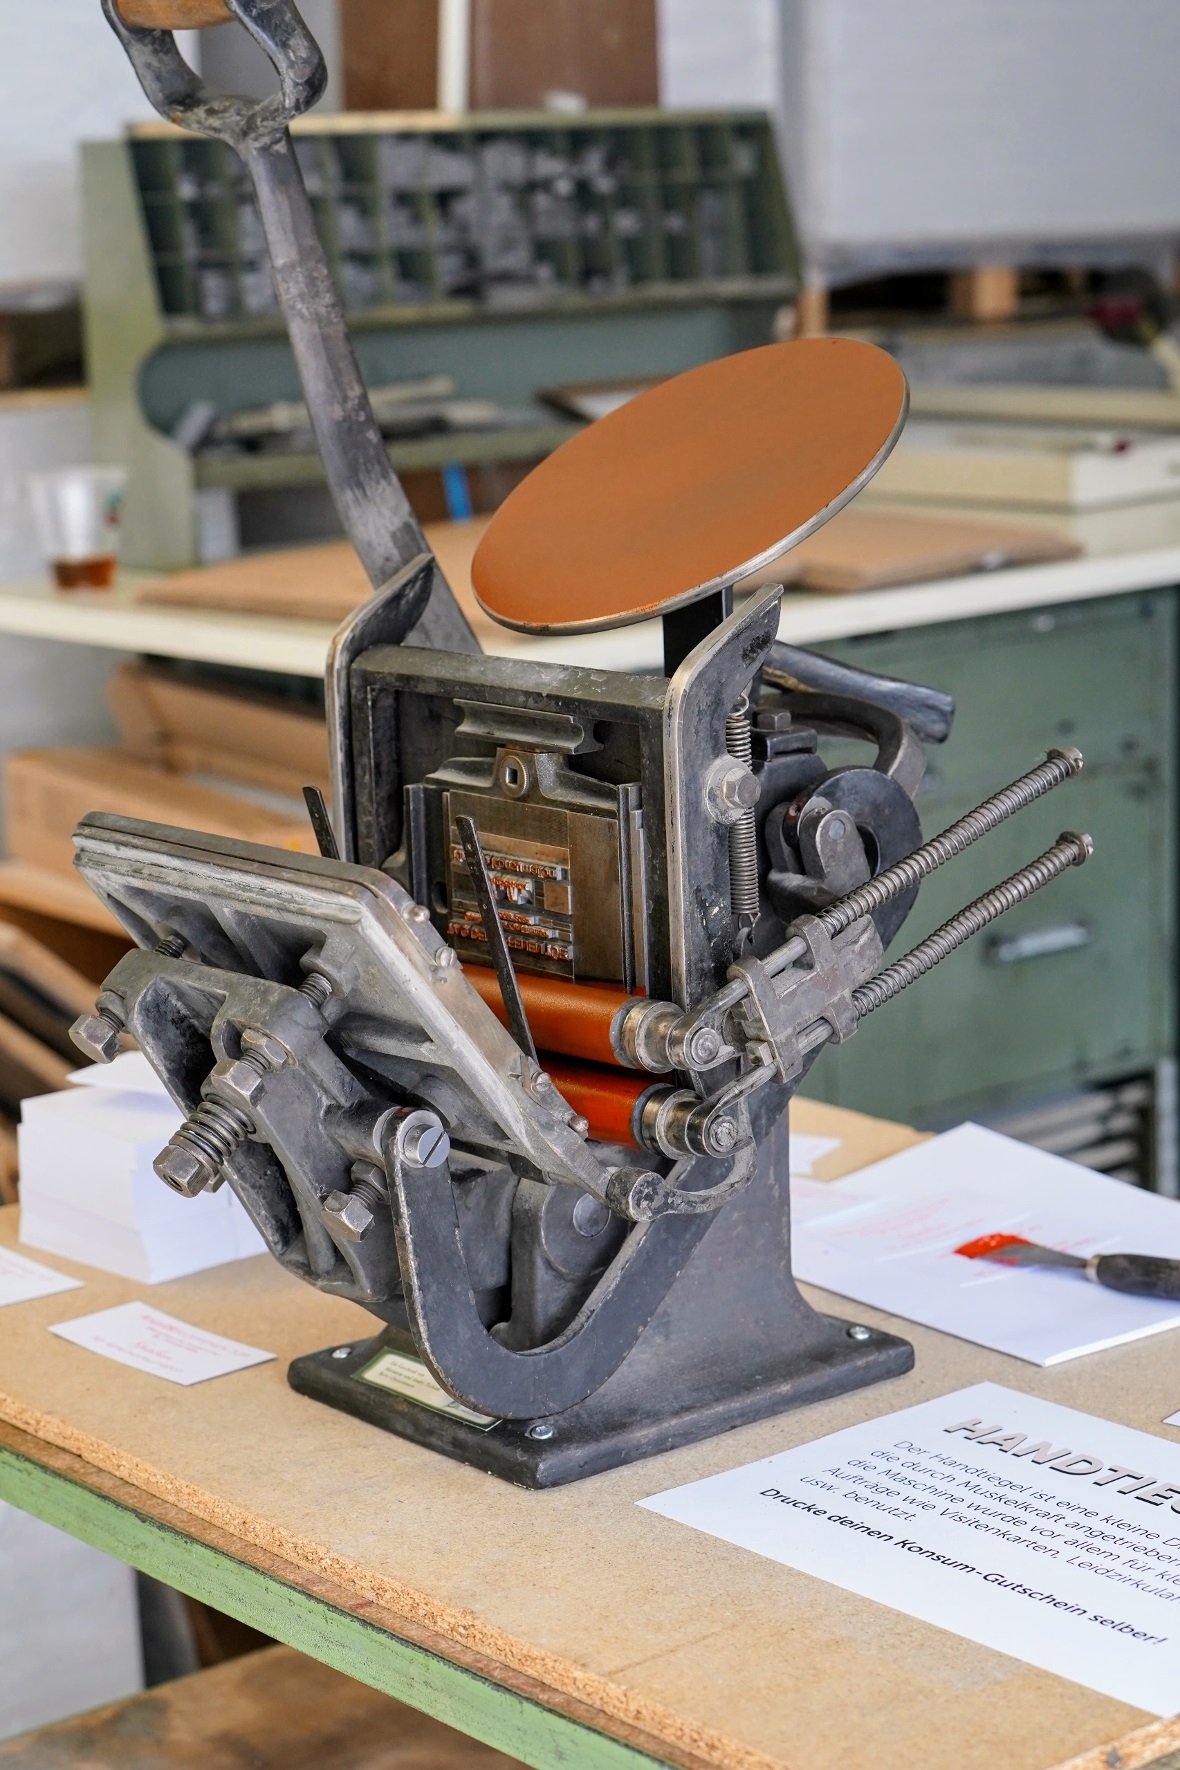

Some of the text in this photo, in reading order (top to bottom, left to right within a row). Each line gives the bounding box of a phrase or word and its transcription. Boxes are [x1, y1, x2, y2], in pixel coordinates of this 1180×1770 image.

[799, 1475, 918, 1522] usw. benutzt.
[821, 1467, 1180, 1603] Aufträge wie Visitenkarten, Leidzirkular
[847, 1458, 877, 1472] die
[877, 1468, 965, 1504] Maschine
[967, 1502, 1028, 1527] wurde
[1030, 1525, 1065, 1539] vor
[1063, 1538, 1121, 1561] allem
[1121, 1558, 1156, 1573] für
[870, 1450, 900, 1463] die
[901, 1460, 956, 1483] durch
[956, 1480, 1066, 1523] Muskelkraft
[893, 1440, 931, 1456] Der
[928, 1453, 1033, 1493] Handtiegel
[1029, 1489, 1057, 1503] ist
[1056, 1500, 1099, 1518] eine
[1099, 1514, 1161, 1540] kleine
[759, 1488, 1169, 1645] Drucke deinen Konsum-Gutschein selber!
